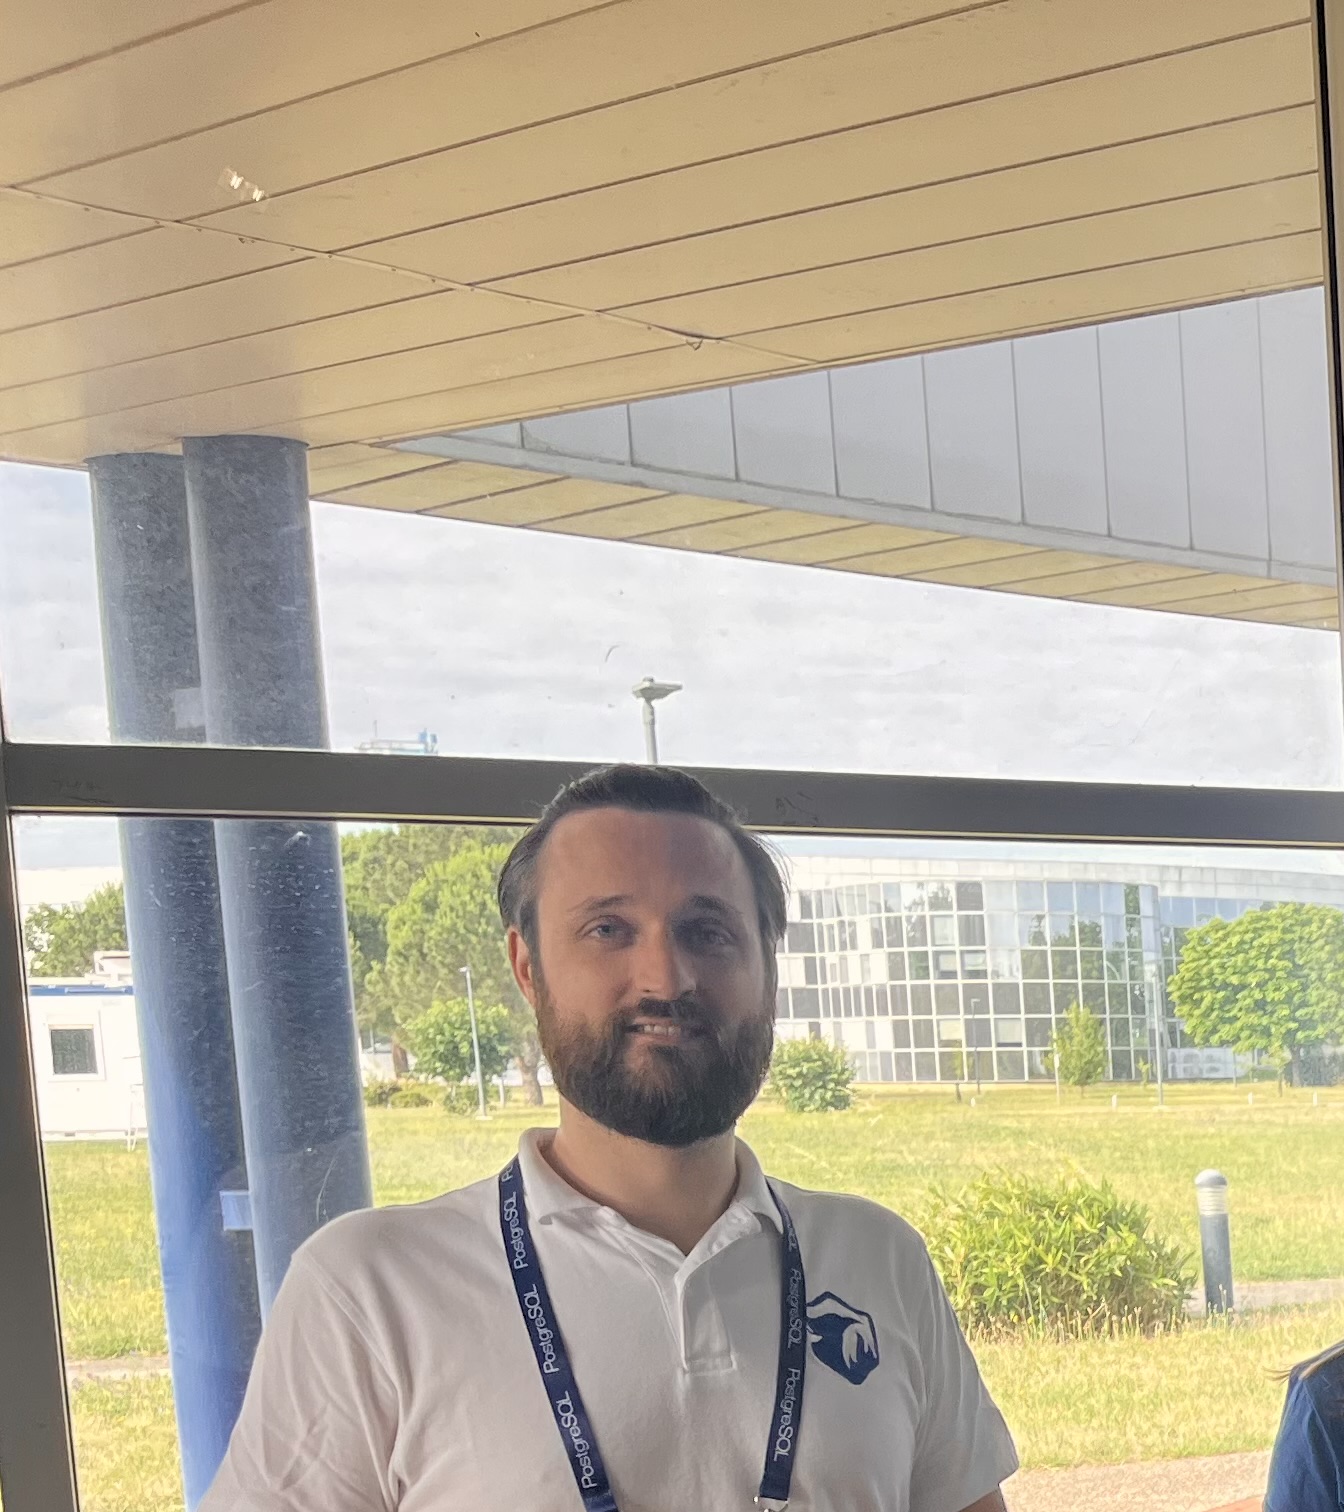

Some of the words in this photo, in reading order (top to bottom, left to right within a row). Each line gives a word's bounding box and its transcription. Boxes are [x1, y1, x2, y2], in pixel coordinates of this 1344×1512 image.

[503, 1191, 529, 1270] PostgreSQL
[523, 1284, 560, 1374] PostgreSQL
[555, 1390, 598, 1489] PostgreSQL
[772, 1366, 801, 1463] PostgreSQL
